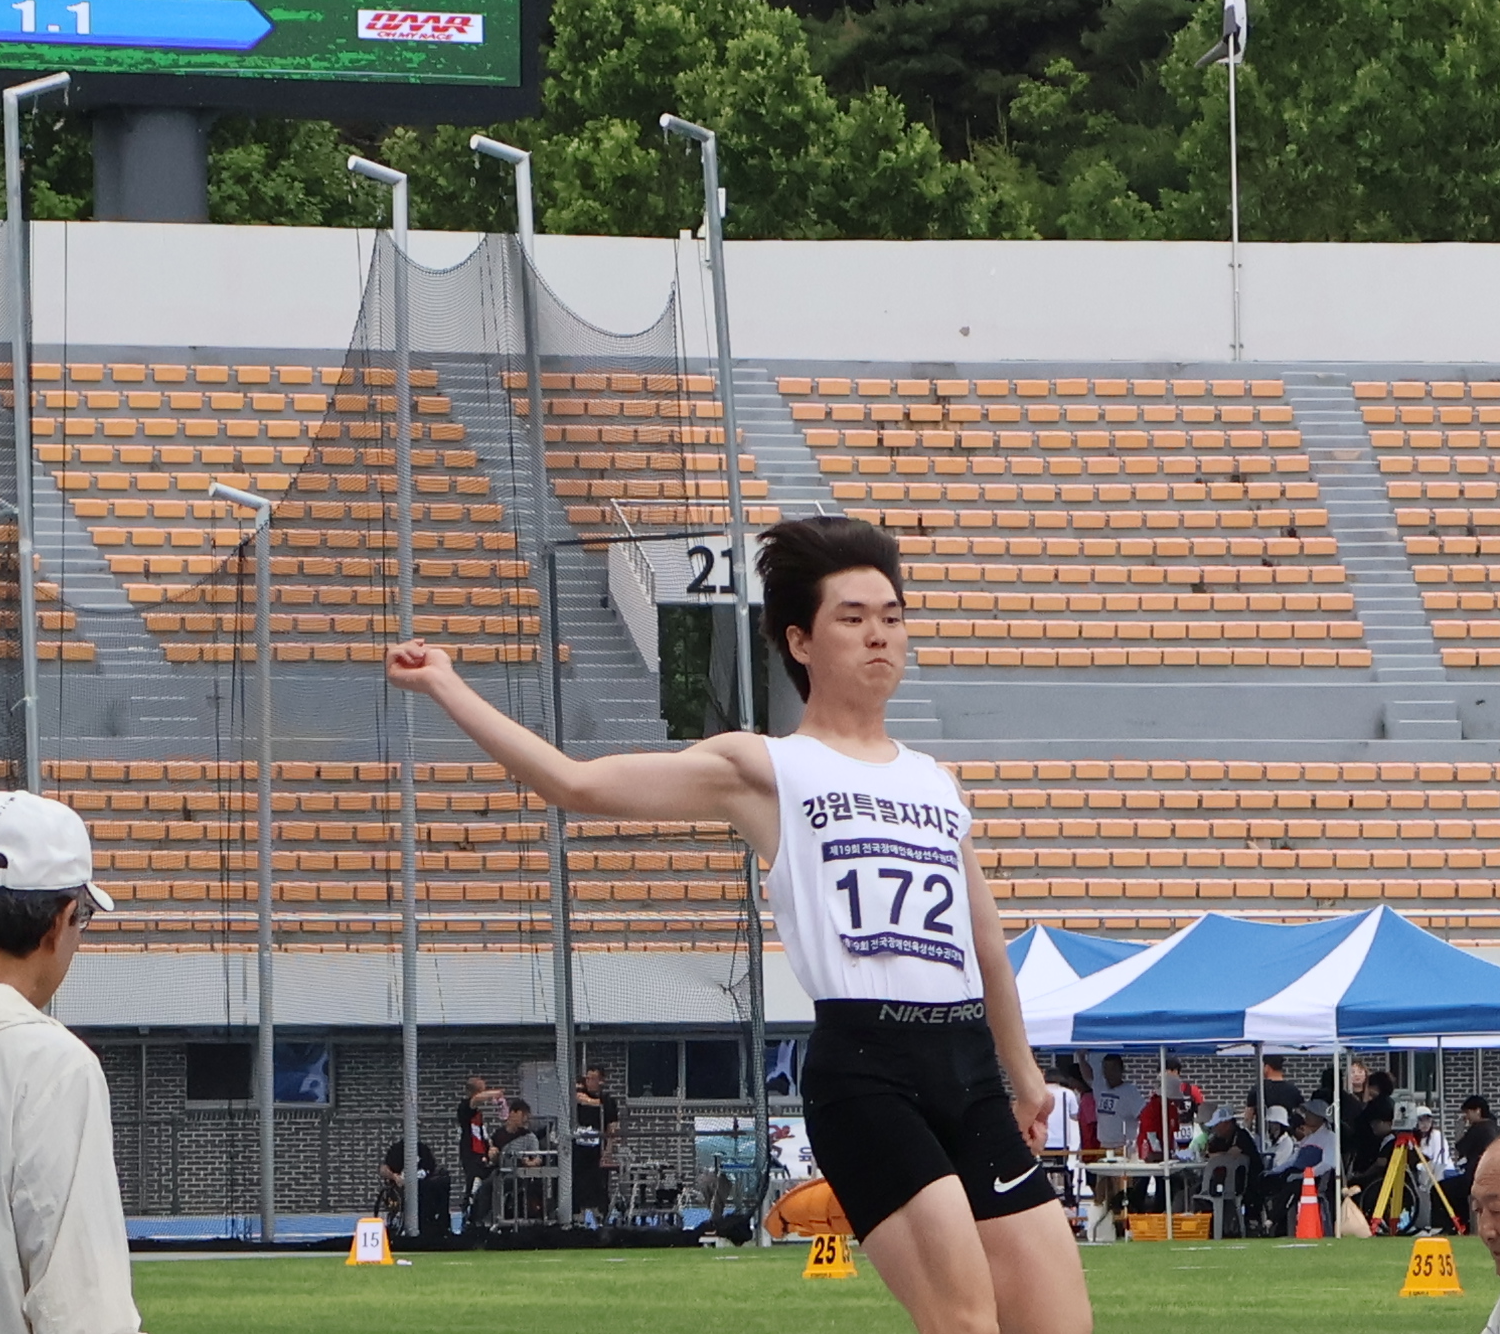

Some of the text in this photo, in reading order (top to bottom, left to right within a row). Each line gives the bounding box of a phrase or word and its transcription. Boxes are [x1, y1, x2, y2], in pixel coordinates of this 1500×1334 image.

[376, 30, 454, 41] OH MY RACE
[686, 545, 736, 593] 21
[802, 792, 960, 842] 강원특별자치도
[835, 868, 954, 936] 172
[878, 1002, 985, 1024] NIKE PRO
[362, 1232, 380, 1248] 15
[813, 1236, 836, 1265] 25
[1412, 1254, 1453, 1277] 35 35
